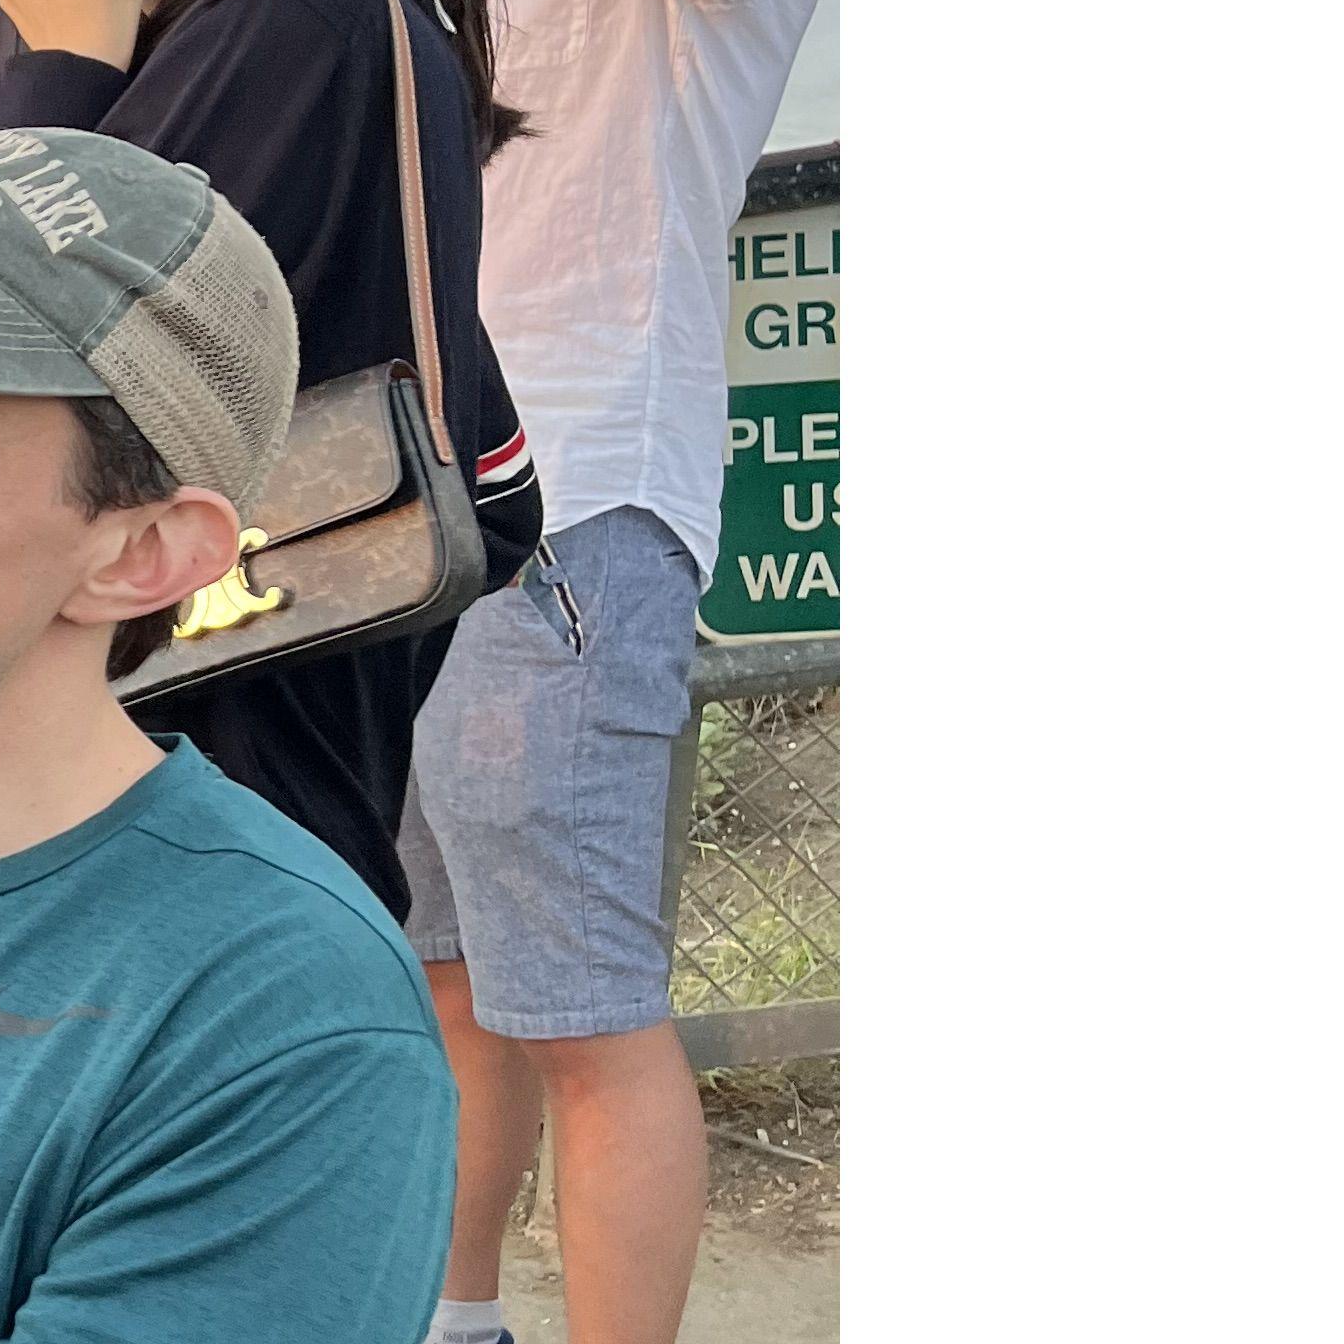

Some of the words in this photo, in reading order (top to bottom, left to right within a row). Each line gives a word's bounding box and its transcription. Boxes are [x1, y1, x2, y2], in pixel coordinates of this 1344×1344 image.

[728, 229, 840, 281] EL
[783, 482, 840, 532] U
[737, 551, 840, 602] WA
